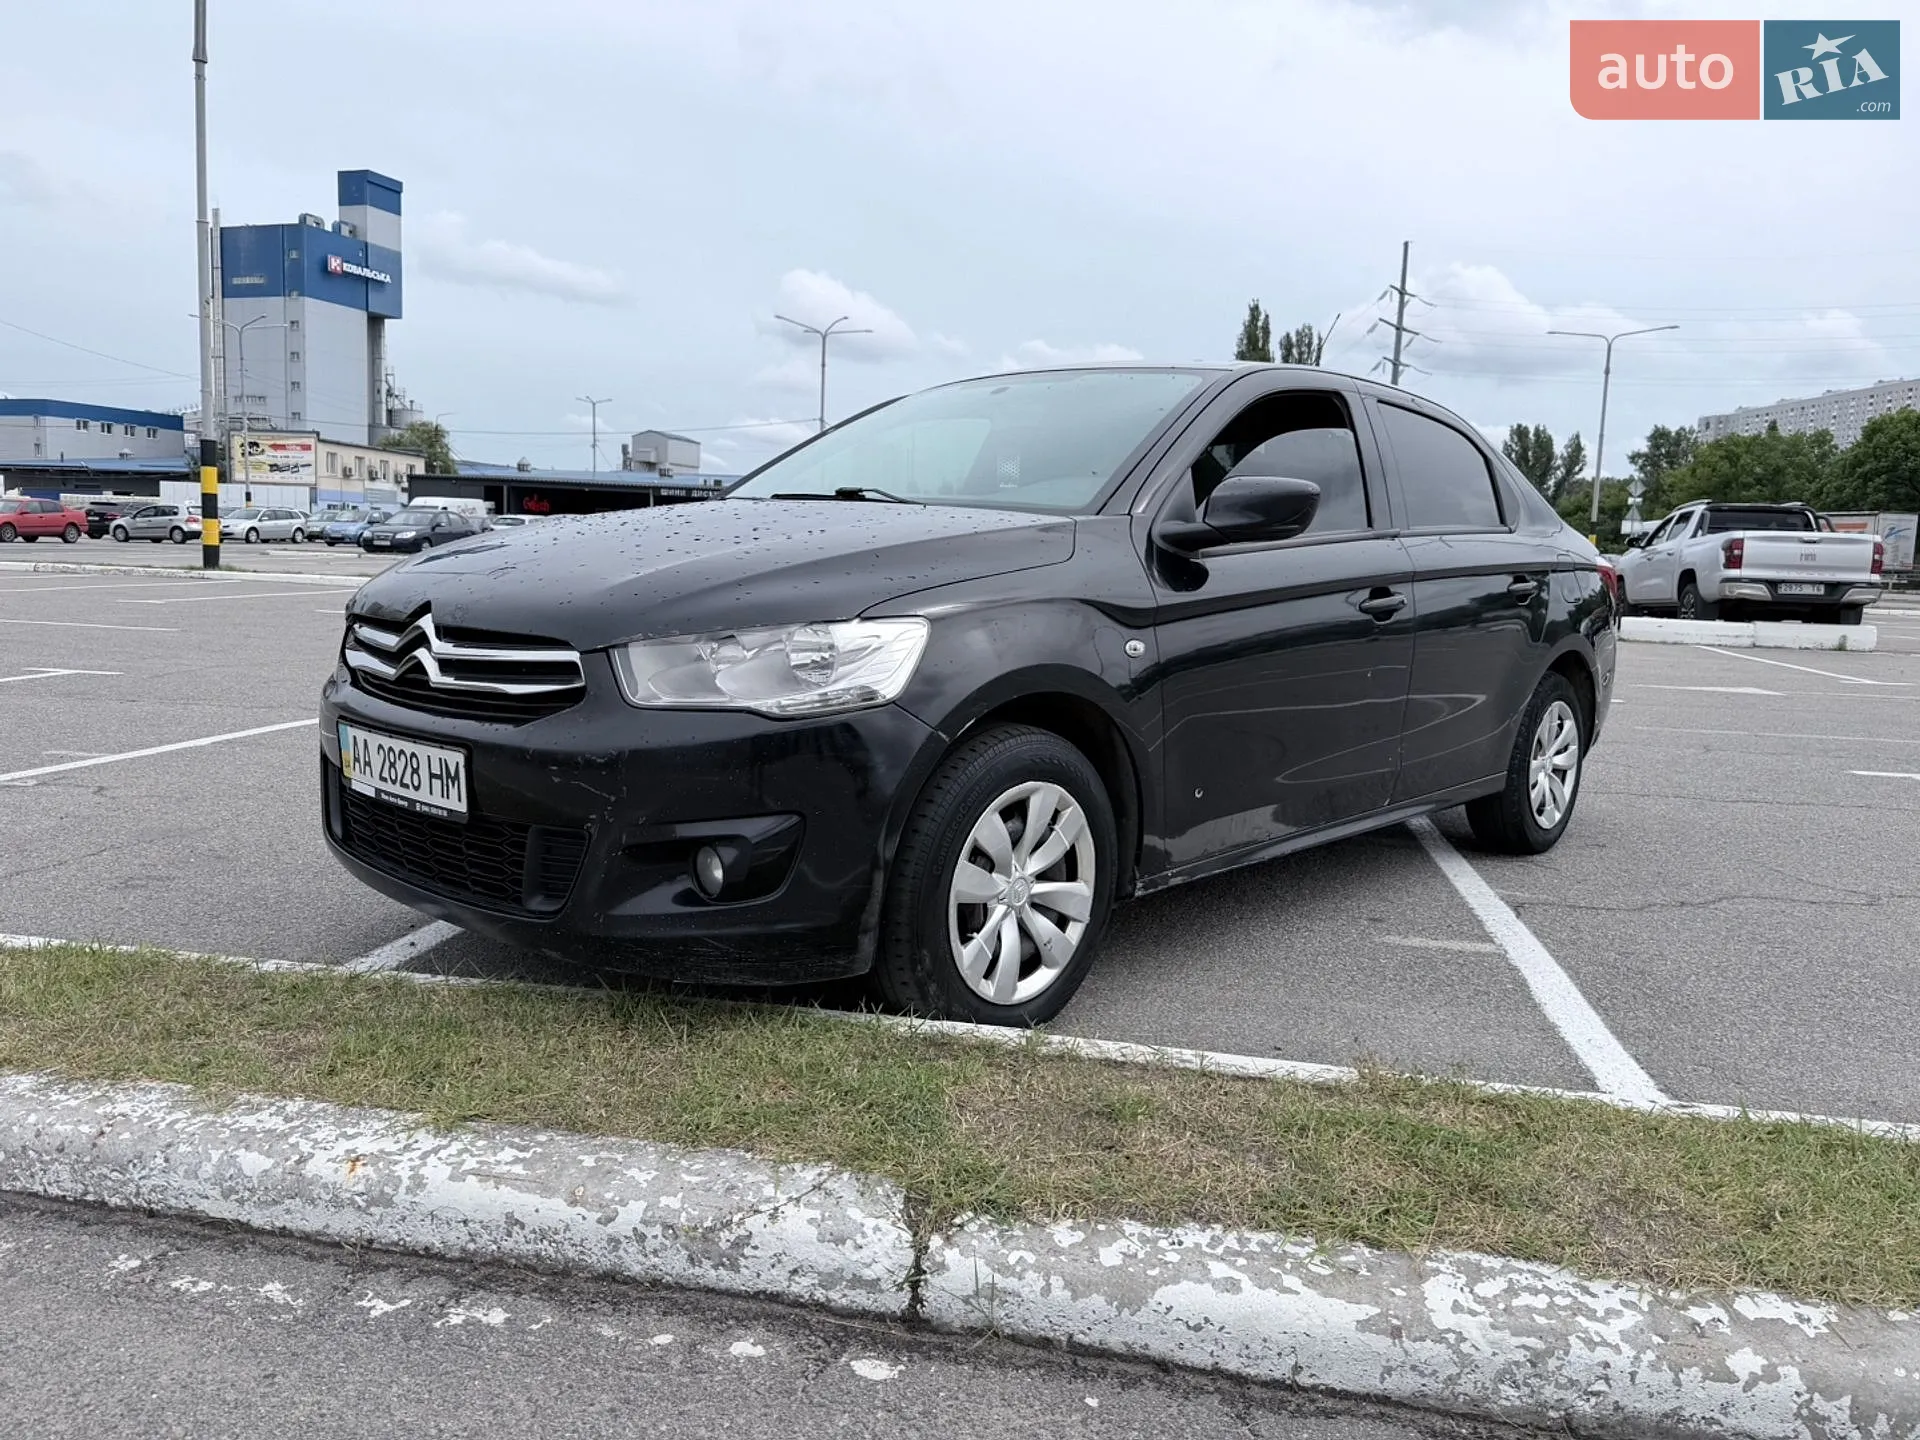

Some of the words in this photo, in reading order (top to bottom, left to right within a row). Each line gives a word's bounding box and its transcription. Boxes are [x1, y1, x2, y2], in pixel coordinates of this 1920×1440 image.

[352, 735, 374, 778] AA
[377, 743, 422, 792] 2828
[427, 754, 462, 803] HM
